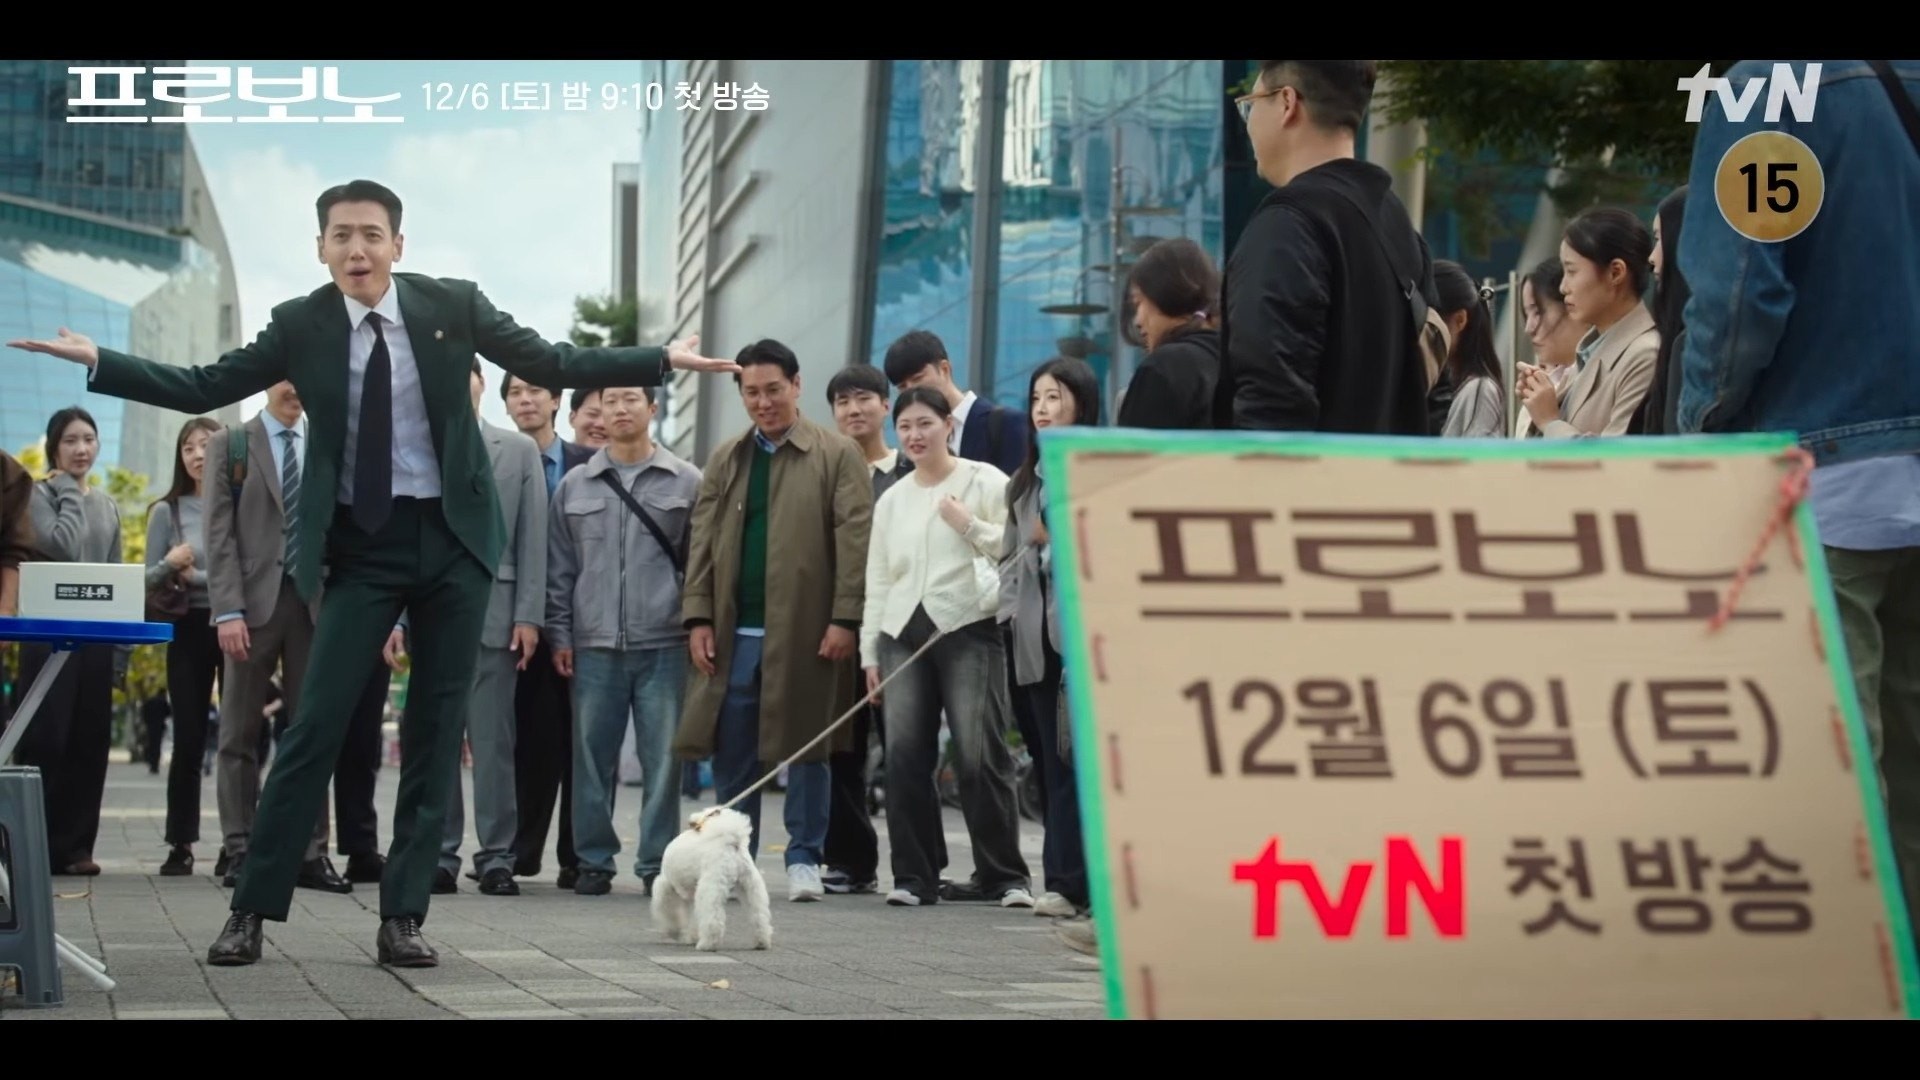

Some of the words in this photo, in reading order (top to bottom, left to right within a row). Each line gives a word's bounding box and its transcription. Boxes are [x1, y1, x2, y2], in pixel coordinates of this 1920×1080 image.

[1129, 509, 1784, 621] 프로보노
[1181, 677, 1395, 781] 12월
[1418, 678, 1584, 781] 6일
[1611, 678, 1782, 780] (토)
[1231, 835, 1468, 940] tvN
[1503, 835, 1603, 937] 첫
[1620, 836, 1815, 937] 방송
